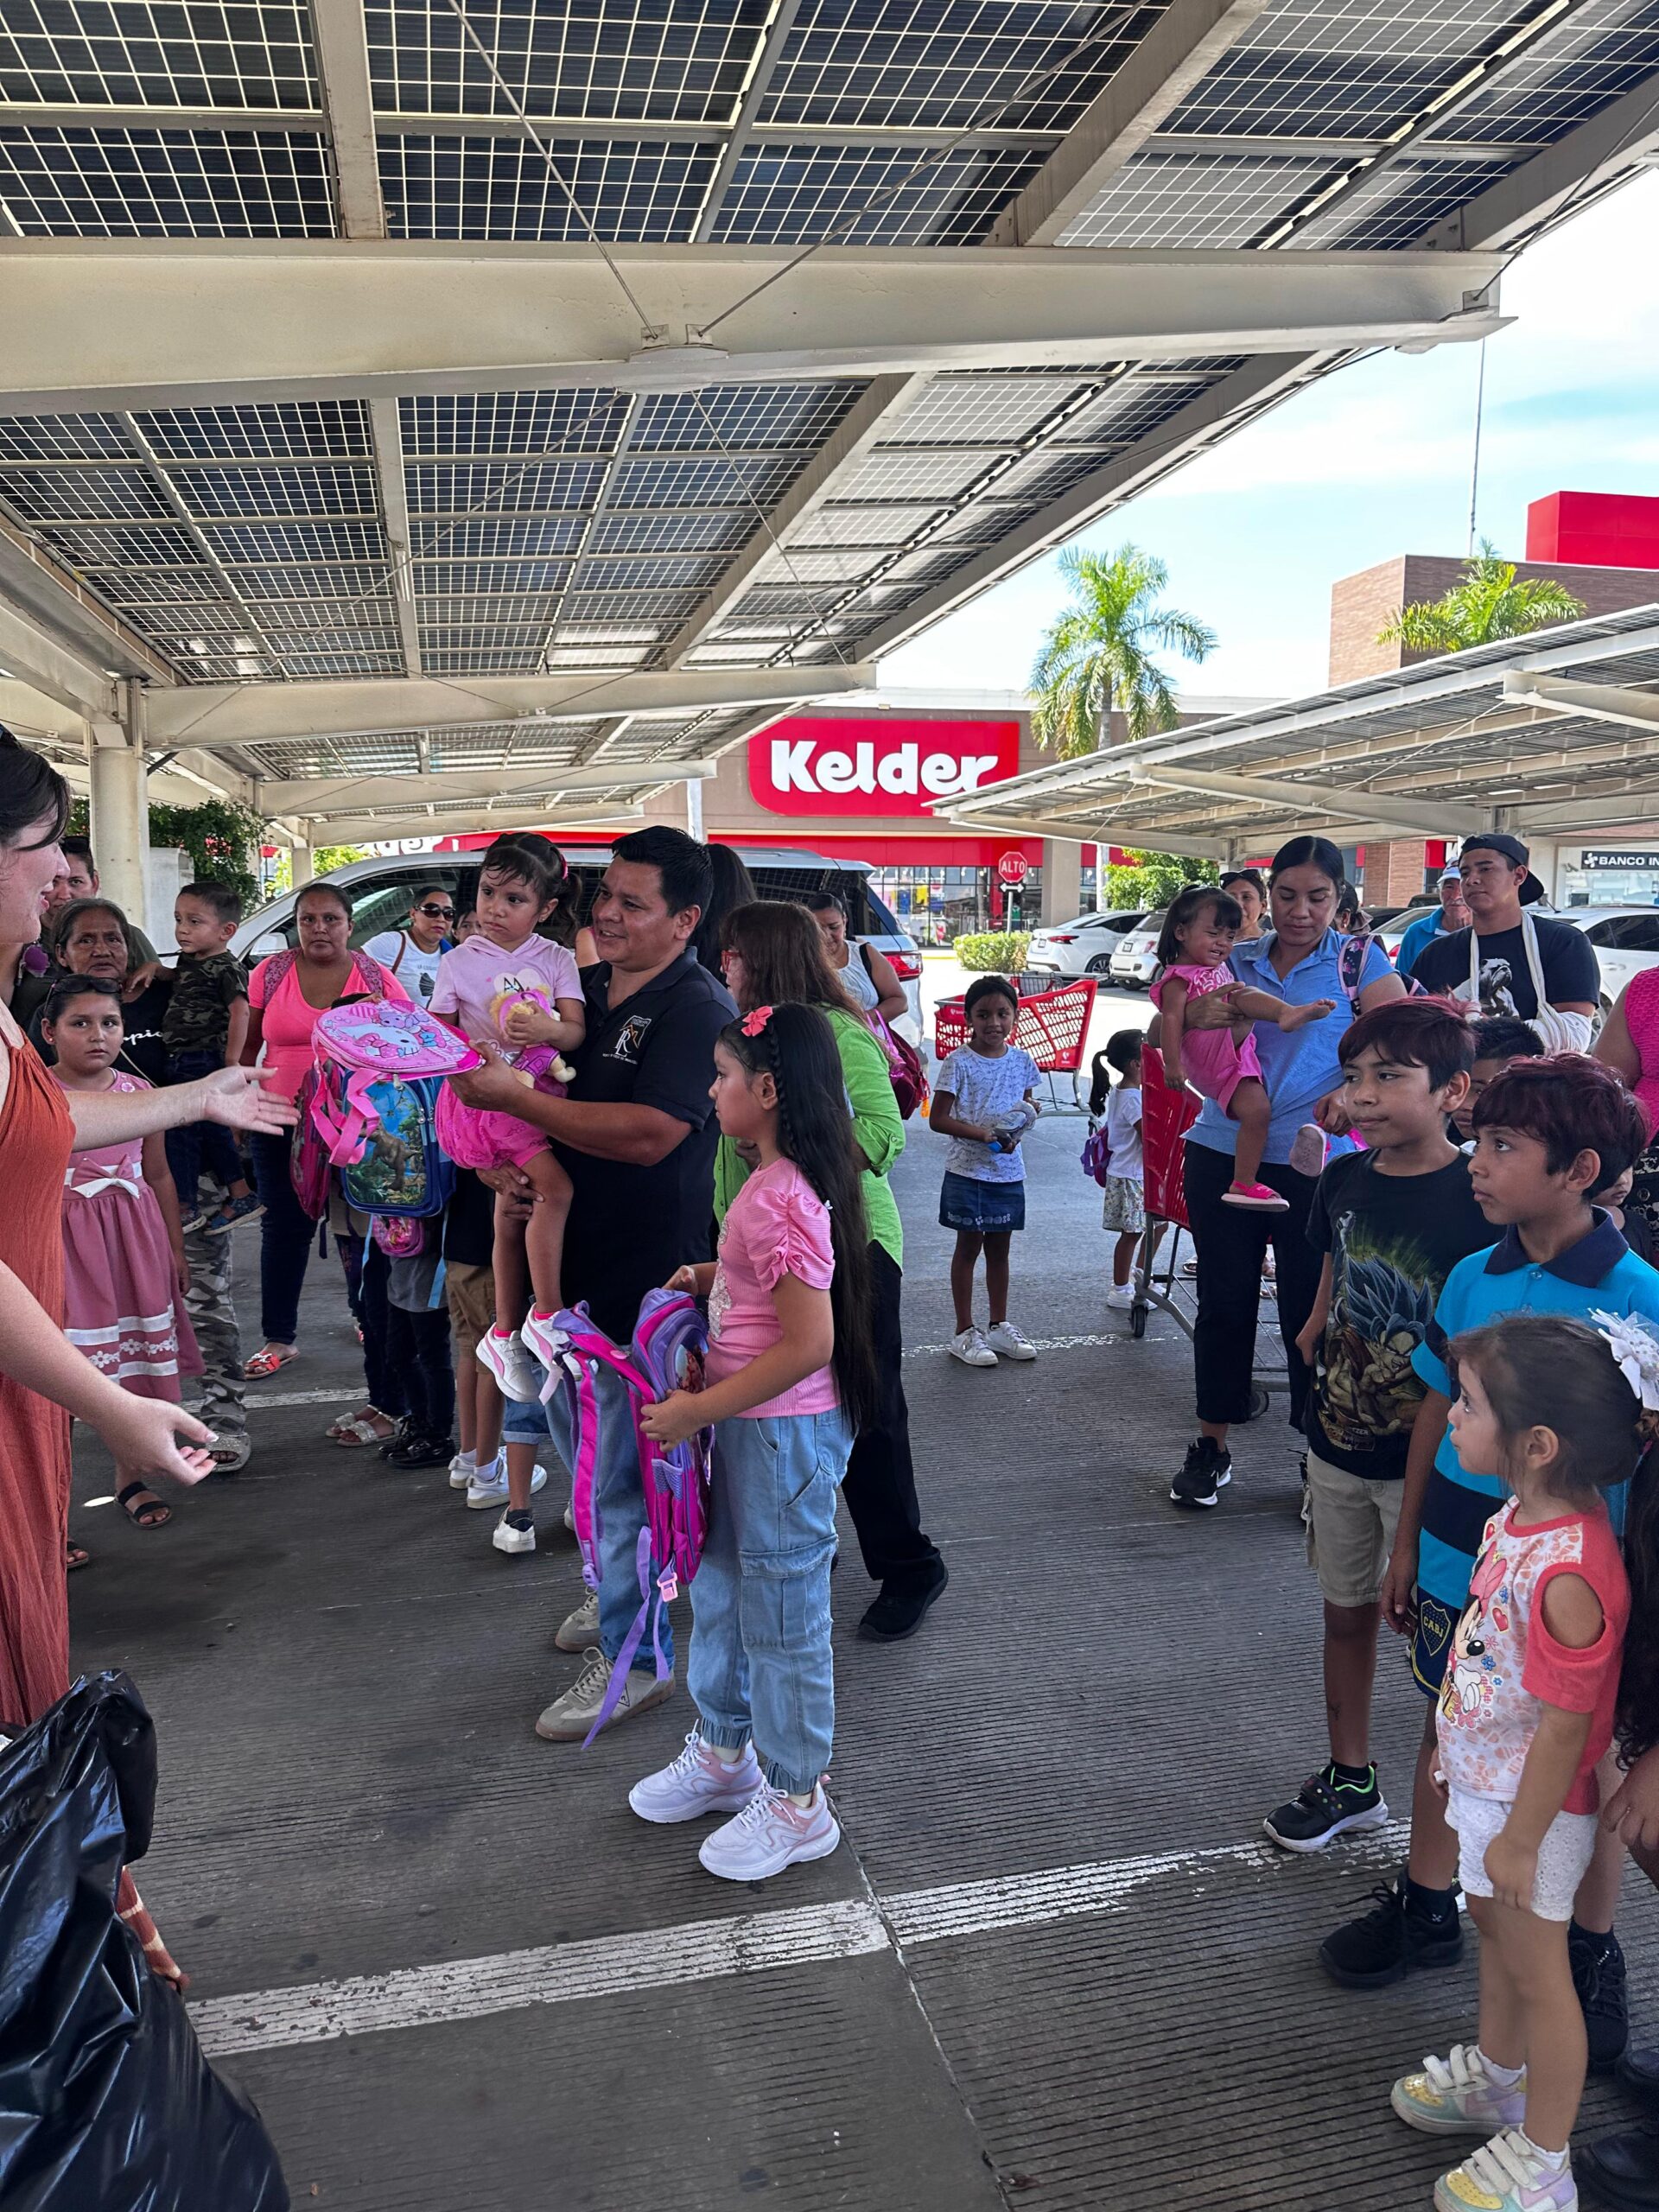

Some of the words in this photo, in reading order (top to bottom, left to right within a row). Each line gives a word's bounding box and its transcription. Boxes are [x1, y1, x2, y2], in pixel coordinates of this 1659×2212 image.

[771, 740, 999, 795] Kelder
[1001, 861, 1026, 874] ALTO
[1599, 856, 1645, 866] BANCO
[1423, 1616, 1444, 1637] CABJ
